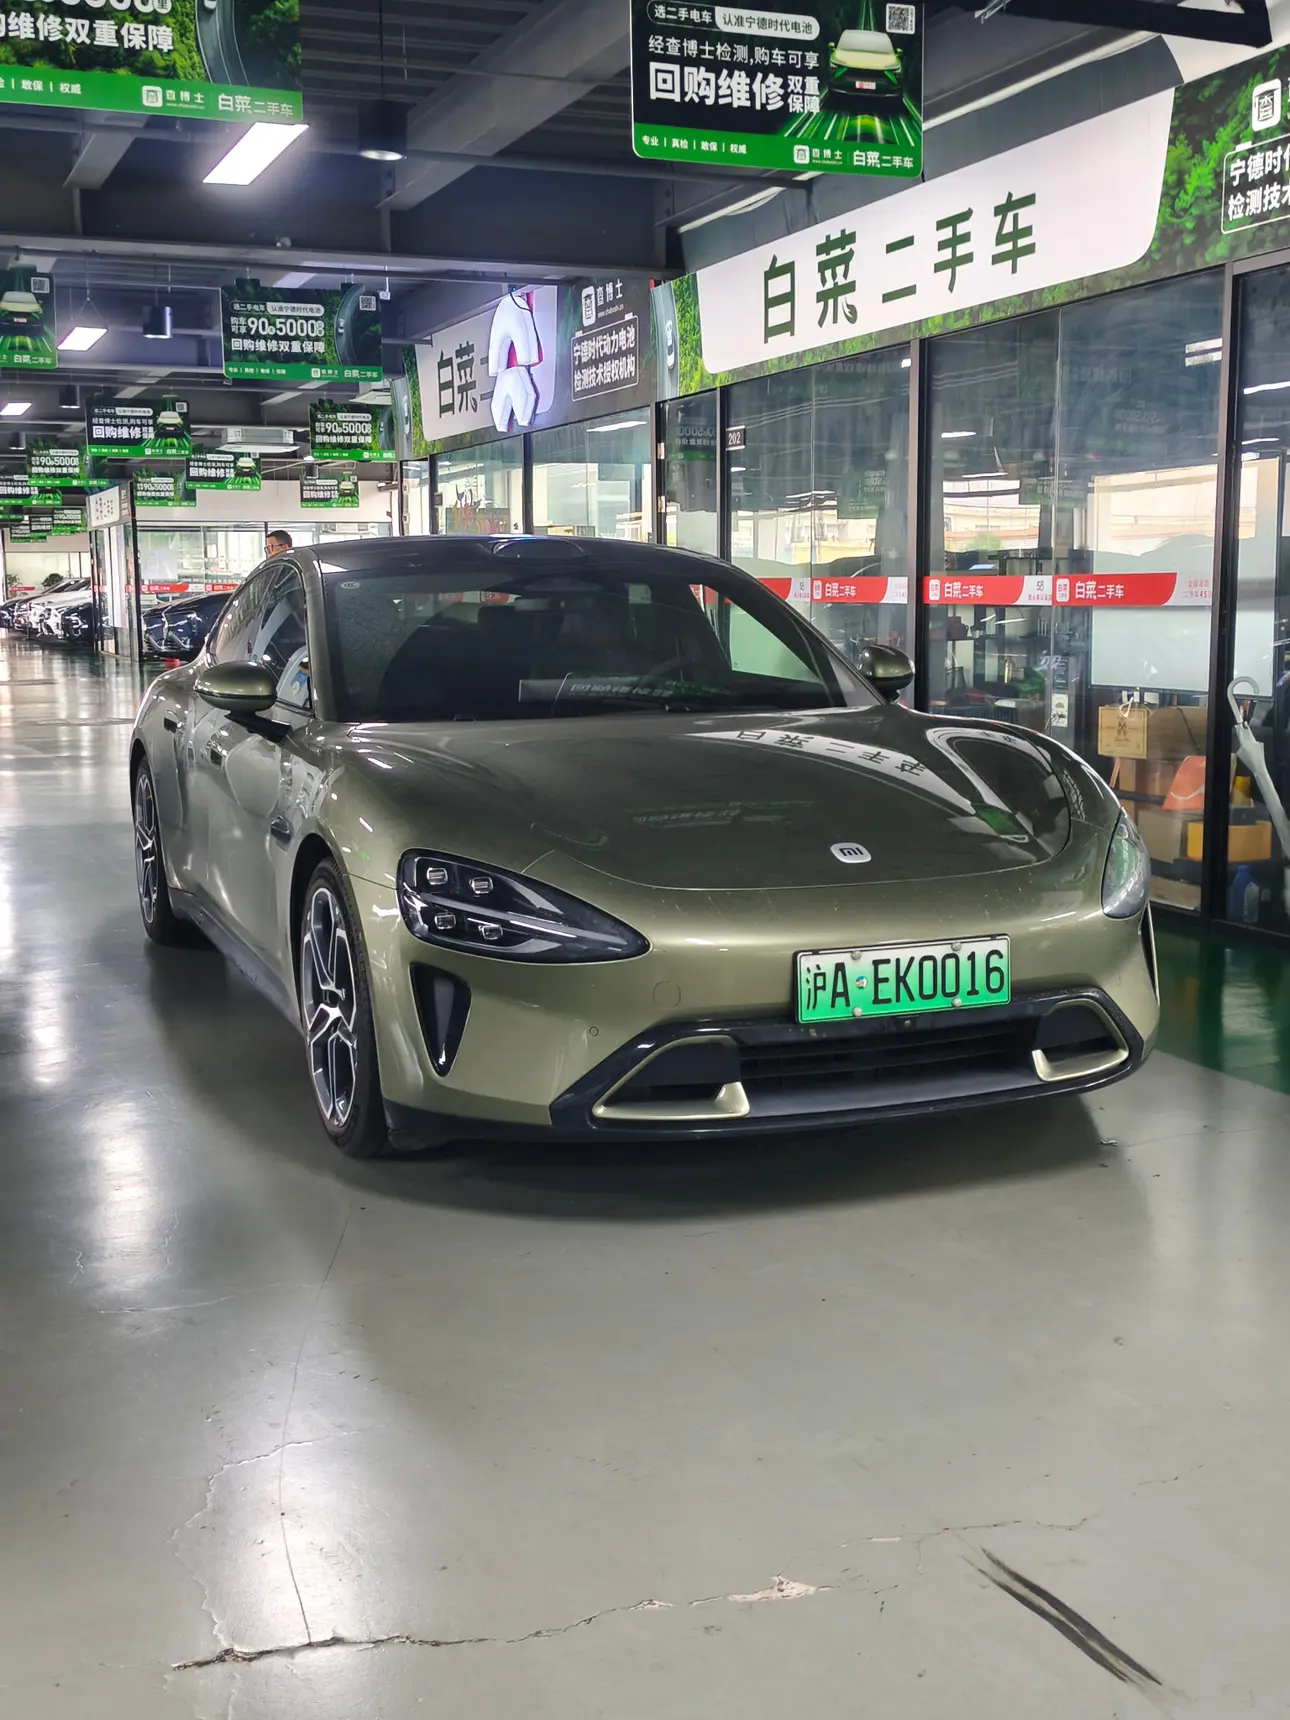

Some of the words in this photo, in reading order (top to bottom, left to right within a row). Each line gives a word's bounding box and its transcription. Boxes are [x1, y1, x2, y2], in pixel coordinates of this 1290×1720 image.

[654, 4, 712, 24] 选二手电车
[722, 13, 813, 34] 认准宁德时代电池
[648, 35, 820, 69] 经查博士检测,购车可享
[649, 61, 785, 111] 回购维修
[787, 75, 820, 95] 双重
[218, 93, 294, 117] 白菜二手车
[787, 94, 820, 114] 保障
[853, 150, 914, 168] 白菜二手车
[763, 190, 1036, 344] 白菜二手车
[596, 278, 623, 306] 查博士
[231, 338, 325, 353] 回购维修双重保障
[573, 324, 636, 366] 宁德时代动力电池
[574, 353, 636, 393] 检测技术授权机构
[92, 425, 141, 439] 回购维修
[728, 431, 741, 445] 202
[825, 582, 856, 597] 白菜二手车
[944, 581, 984, 599] 白菜二手车
[1075, 580, 1124, 600] 白菜二手车
